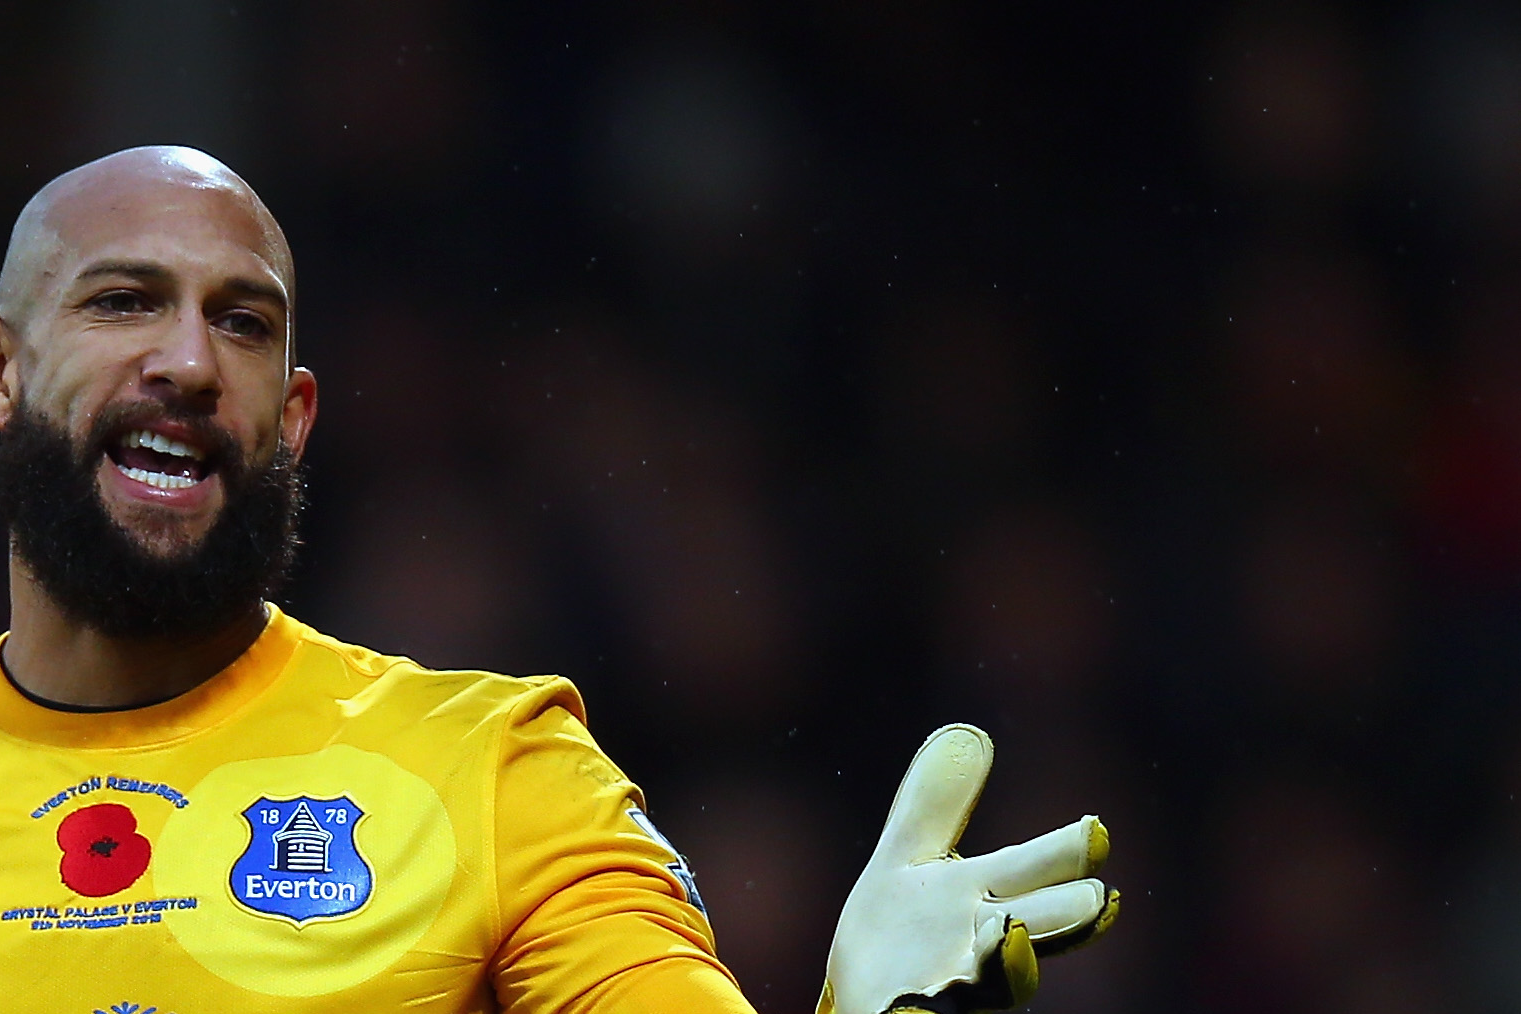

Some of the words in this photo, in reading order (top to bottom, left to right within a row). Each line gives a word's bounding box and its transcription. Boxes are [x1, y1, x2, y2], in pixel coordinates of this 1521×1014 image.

[31, 776, 100, 818] EVERTON
[260, 810, 279, 824] 18
[325, 809, 347, 824] 78
[246, 875, 355, 901] Everton
[2, 907, 60, 920] CRYSTAL
[65, 906, 117, 918] PALACE
[134, 898, 197, 913] EVERTON
